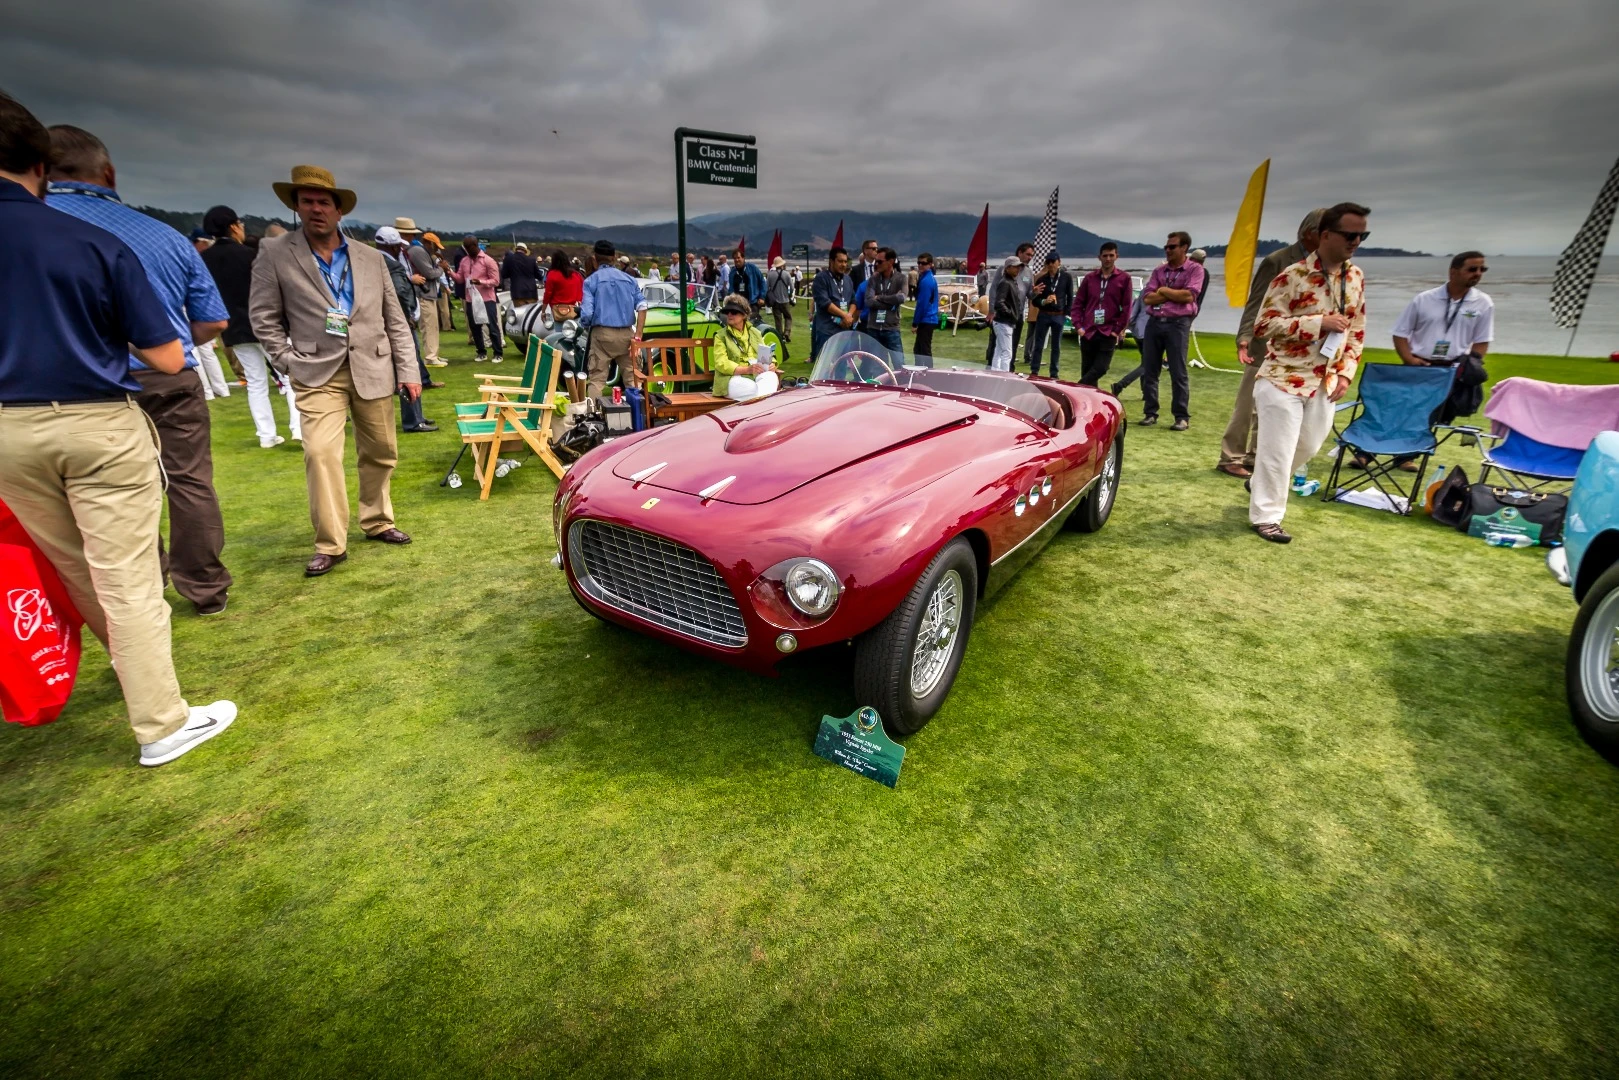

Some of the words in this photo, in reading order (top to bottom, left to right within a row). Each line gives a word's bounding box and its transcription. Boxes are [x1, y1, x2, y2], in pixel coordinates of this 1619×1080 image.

[699, 146, 726, 158] Class
[728, 149, 745, 160] N-1
[688, 159, 712, 170] BMW
[713, 162, 756, 174] Centennial
[710, 174, 735, 183] Prewar
